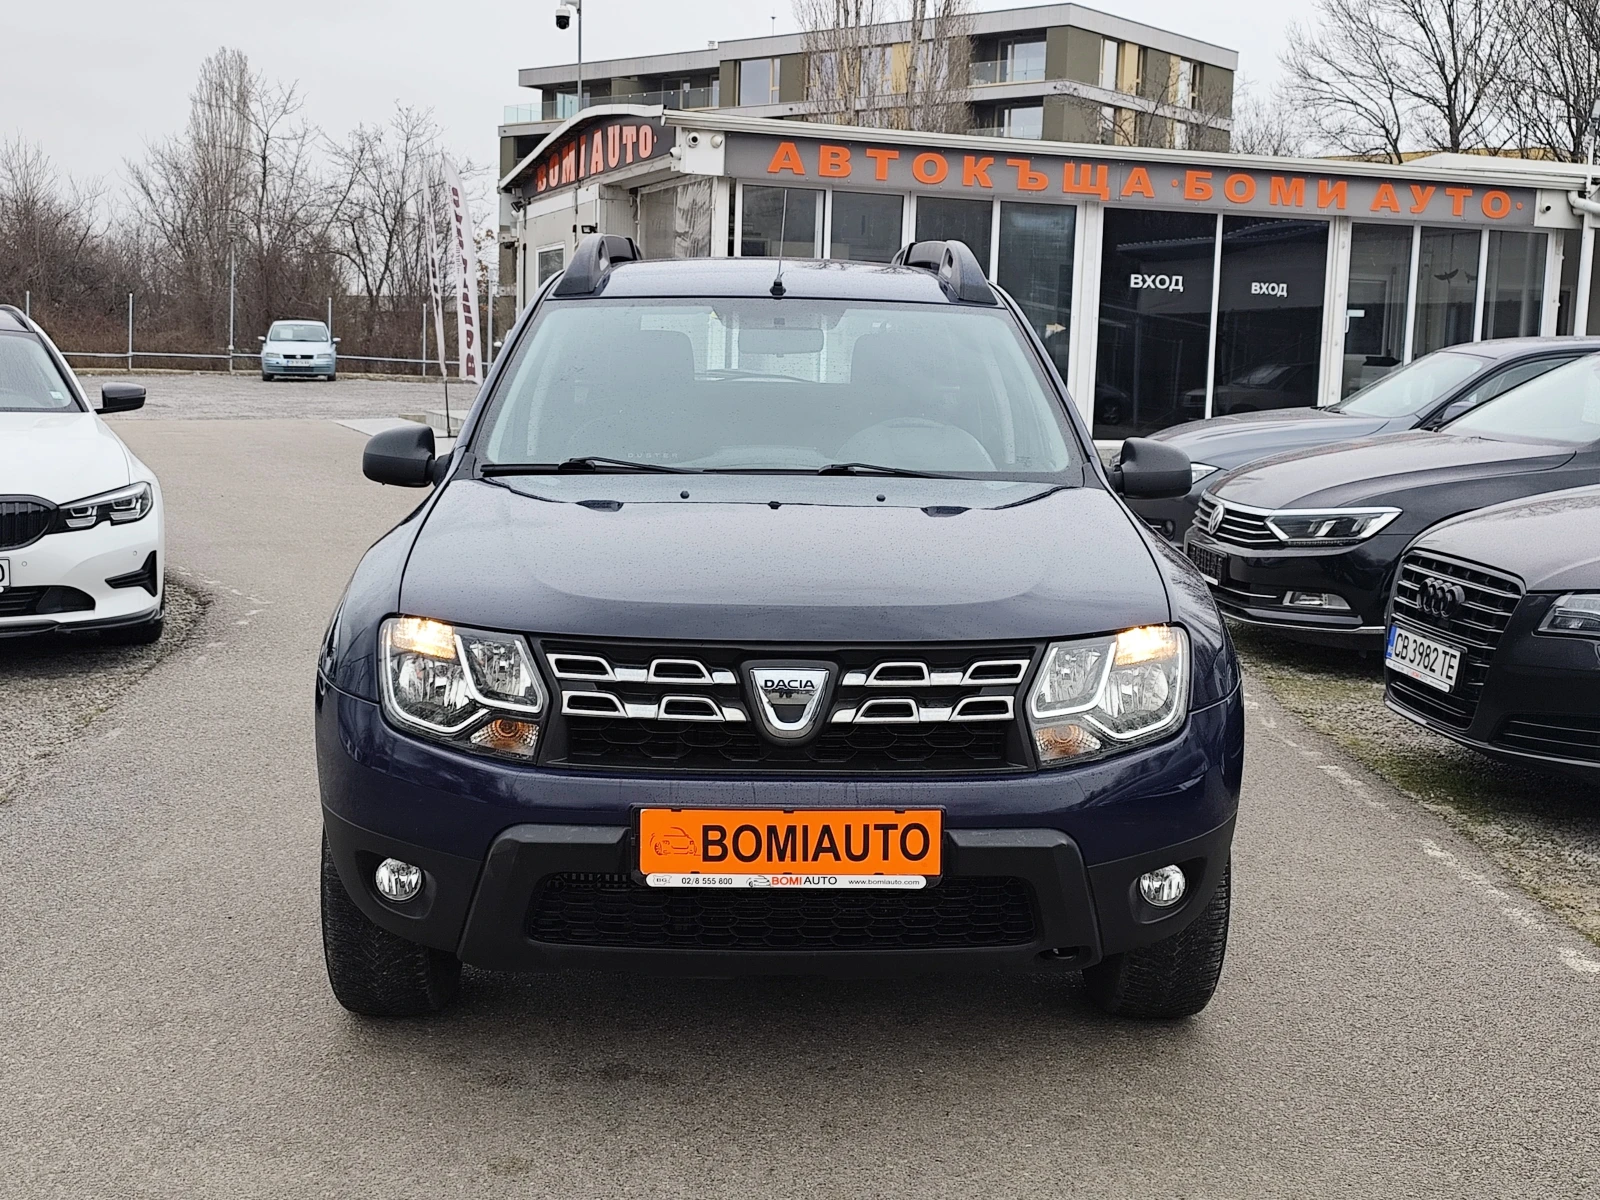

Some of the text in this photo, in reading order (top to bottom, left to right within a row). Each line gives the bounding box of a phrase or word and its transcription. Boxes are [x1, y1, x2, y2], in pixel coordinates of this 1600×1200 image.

[767, 142, 1512, 220] АВТОКЪЩА БОМИ АУТО
[1130, 273, 1184, 292] ВХОД
[1251, 282, 1288, 297] ВХОД
[1394, 632, 1410, 660] CB
[1409, 639, 1439, 673] 3982
[1440, 650, 1458, 681] TE
[764, 679, 815, 689] DACIA
[701, 822, 930, 862] BOMIAUTO
[681, 877, 733, 885] 02/8 555 800
[771, 876, 838, 886] BOMI AUTO
